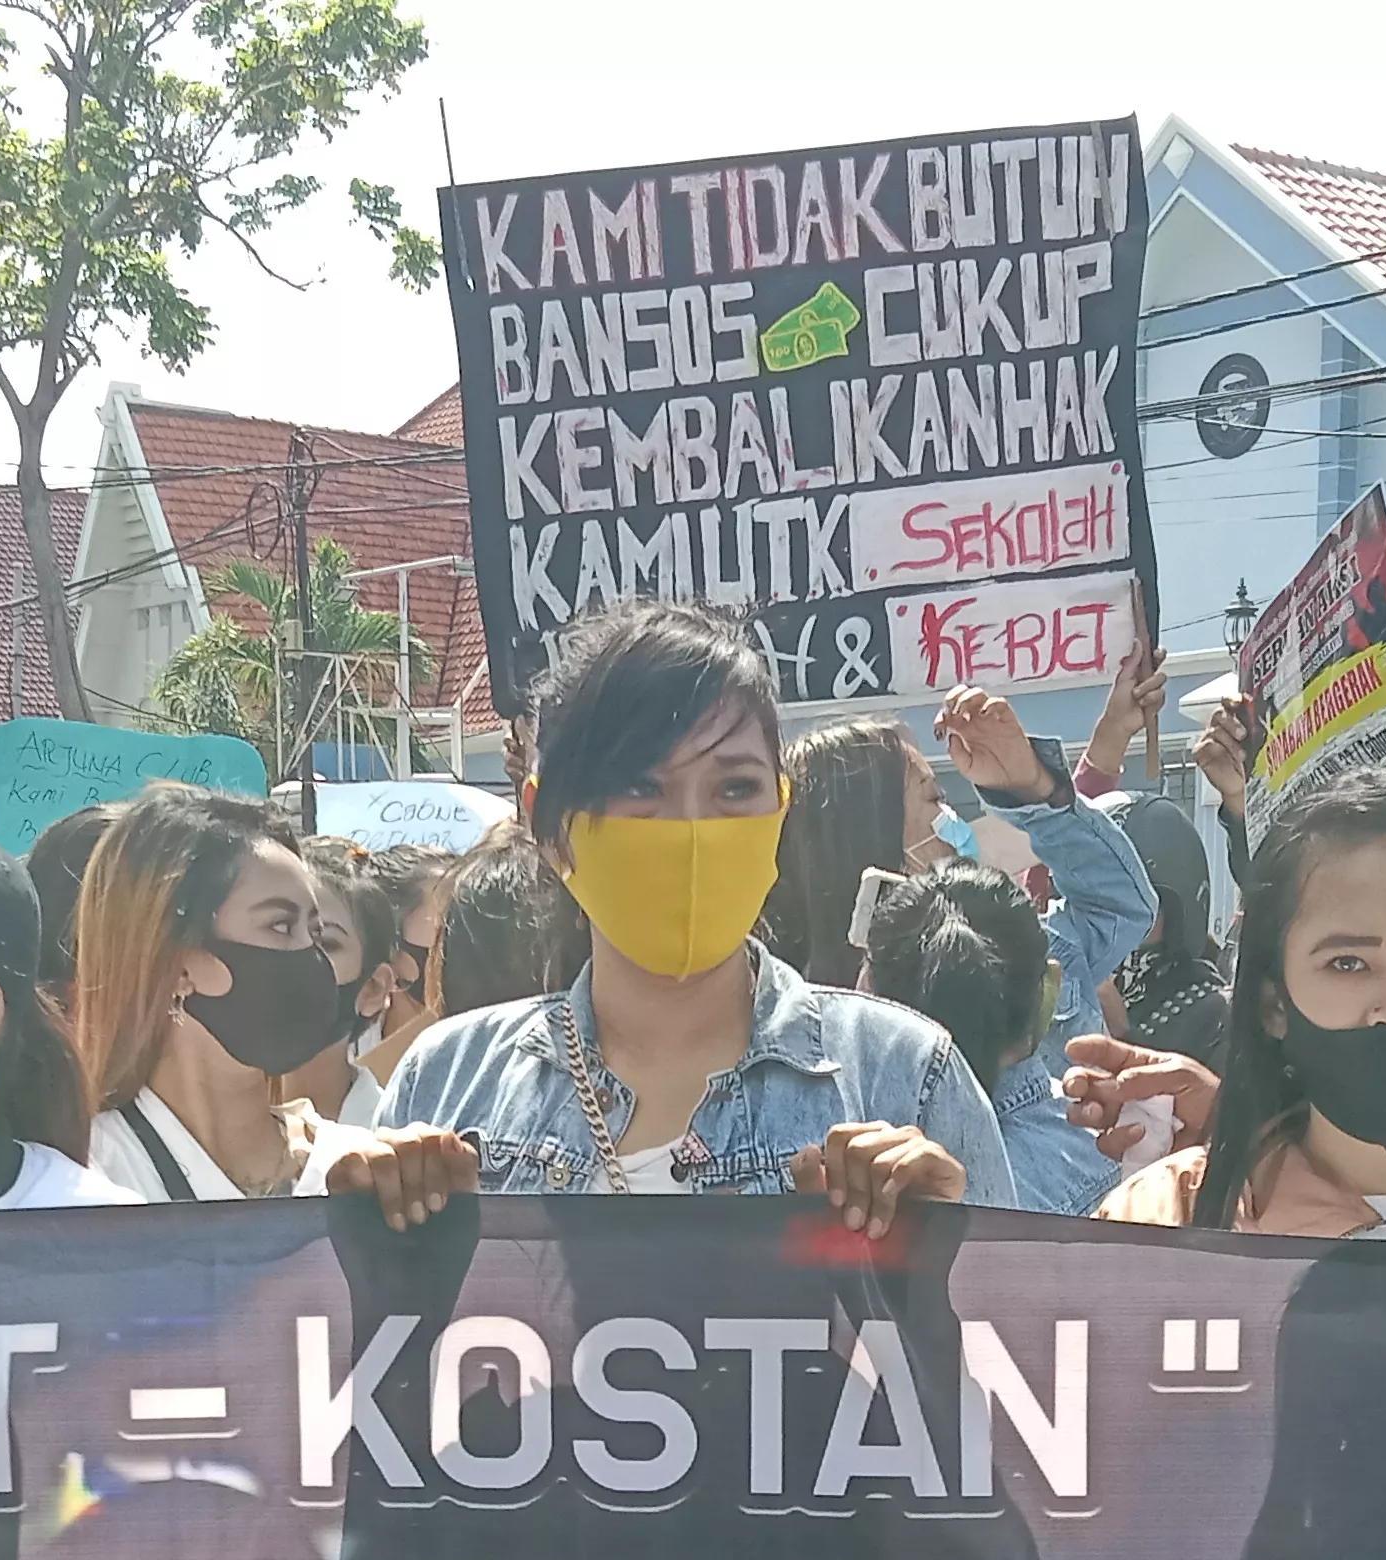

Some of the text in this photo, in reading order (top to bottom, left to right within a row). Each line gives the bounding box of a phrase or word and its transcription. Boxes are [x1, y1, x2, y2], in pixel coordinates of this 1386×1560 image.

[477, 134, 1129, 294] KAMI TIDAK BUTUH
[490, 241, 1113, 405] BANSOS CUKUP
[510, 506, 693, 631] KAMI
[832, 616, 879, 699] &
[1311, 654, 1382, 730] BERGERAK
[16, 731, 122, 776] ARJUNA
[296, 1314, 1089, 1498] KOSTAN
